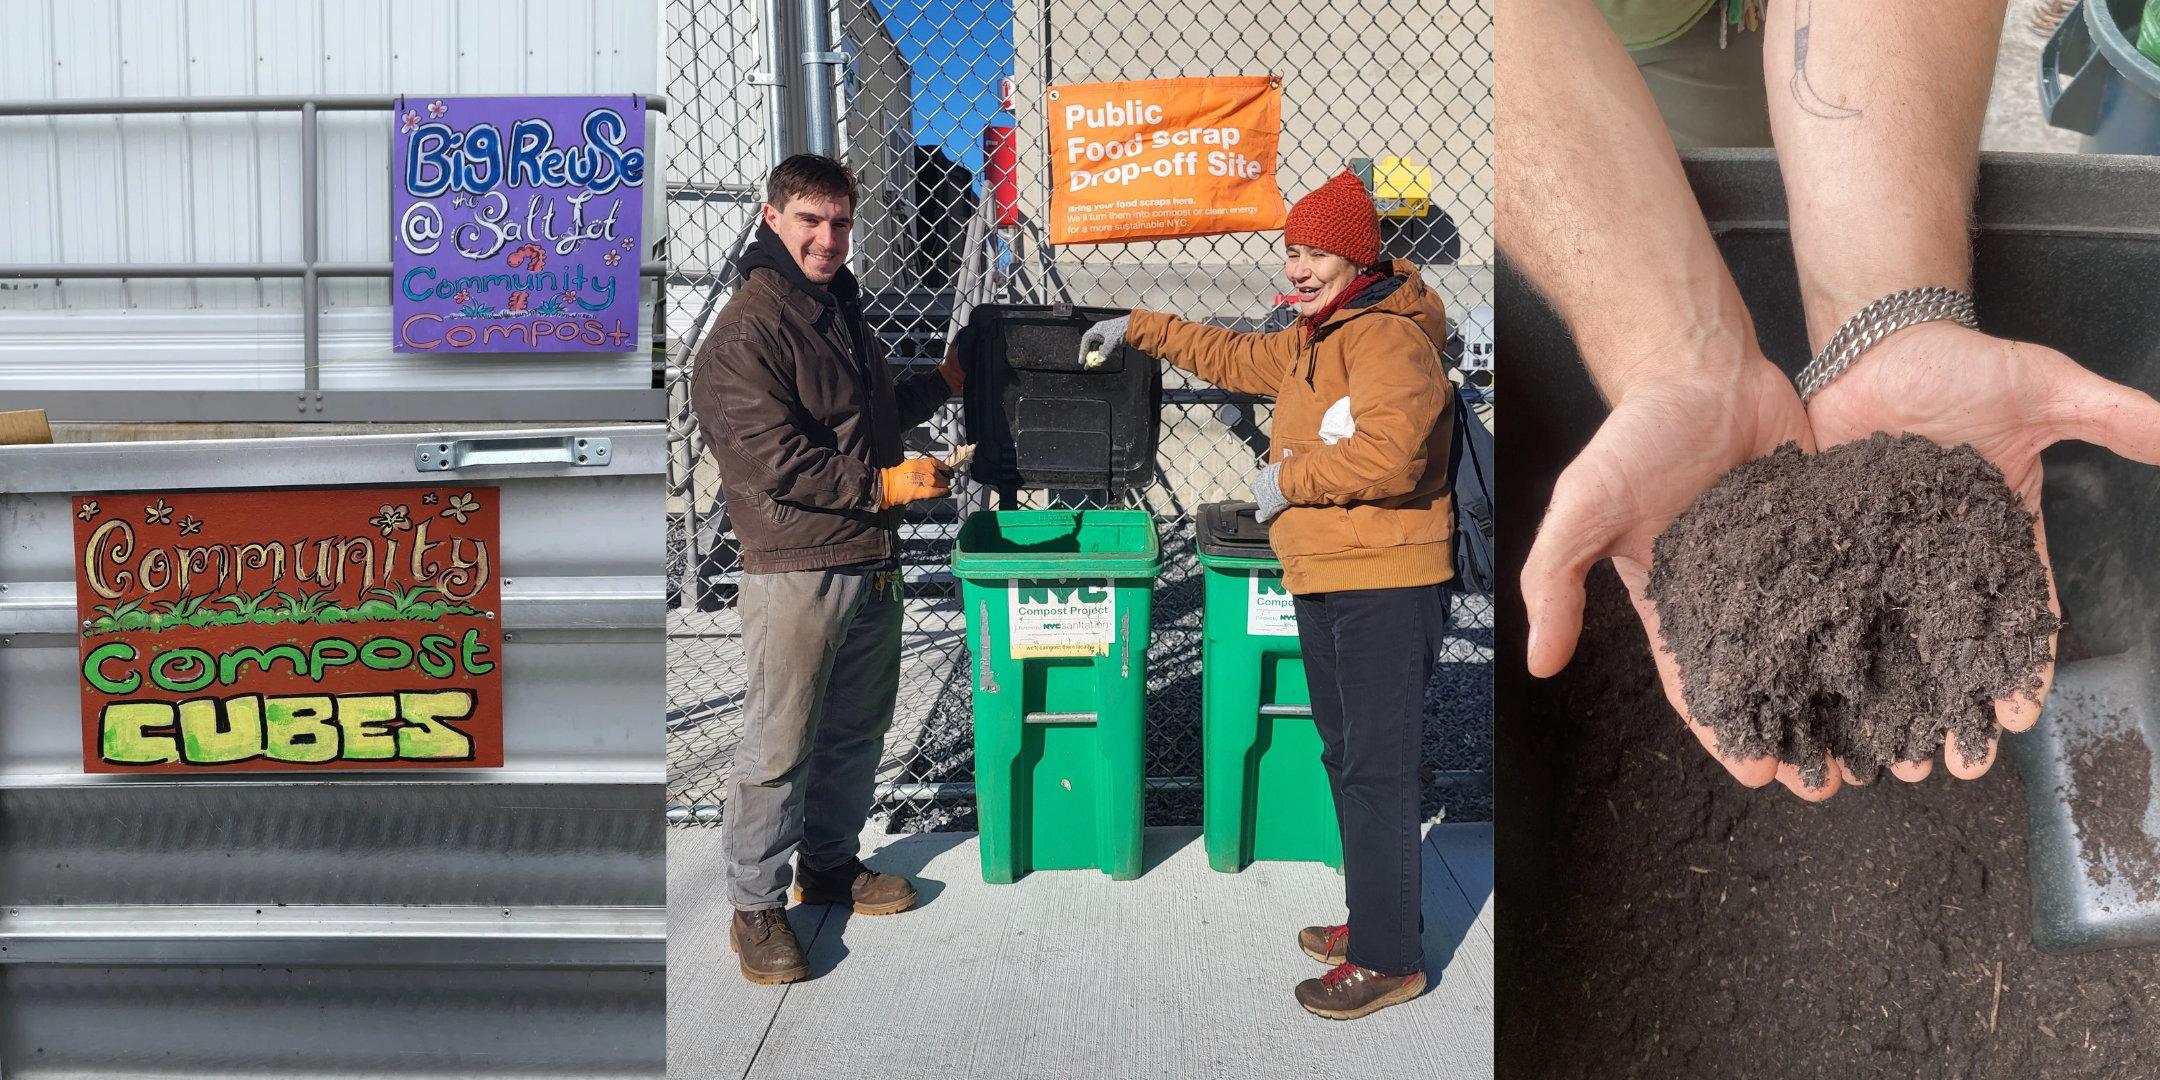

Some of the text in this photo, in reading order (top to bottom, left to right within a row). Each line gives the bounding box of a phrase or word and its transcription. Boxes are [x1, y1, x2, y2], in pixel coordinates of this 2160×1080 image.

[1065, 99, 1163, 131] Public
[405, 122, 505, 198] Big
[1067, 133, 1143, 164] Food
[1069, 150, 1262, 193] Drop-off Site
[1067, 206, 1258, 223] We'll turn them into compost or clean energy
[1068, 197, 1197, 213] Bring your food scraps here.
[401, 201, 444, 256] @
[454, 191, 559, 262] Salt
[1067, 225, 1080, 234] for
[1090, 224, 1112, 232] more
[1114, 219, 1164, 231] sustainable
[1166, 219, 1189, 228] NYC.
[402, 263, 616, 310] Community
[401, 313, 630, 349] Compost
[83, 518, 491, 601] Community
[1018, 579, 1107, 604] NYC
[1018, 606, 1108, 616] Compost Project
[82, 628, 495, 695] Compost
[98, 688, 480, 765] CUBES
